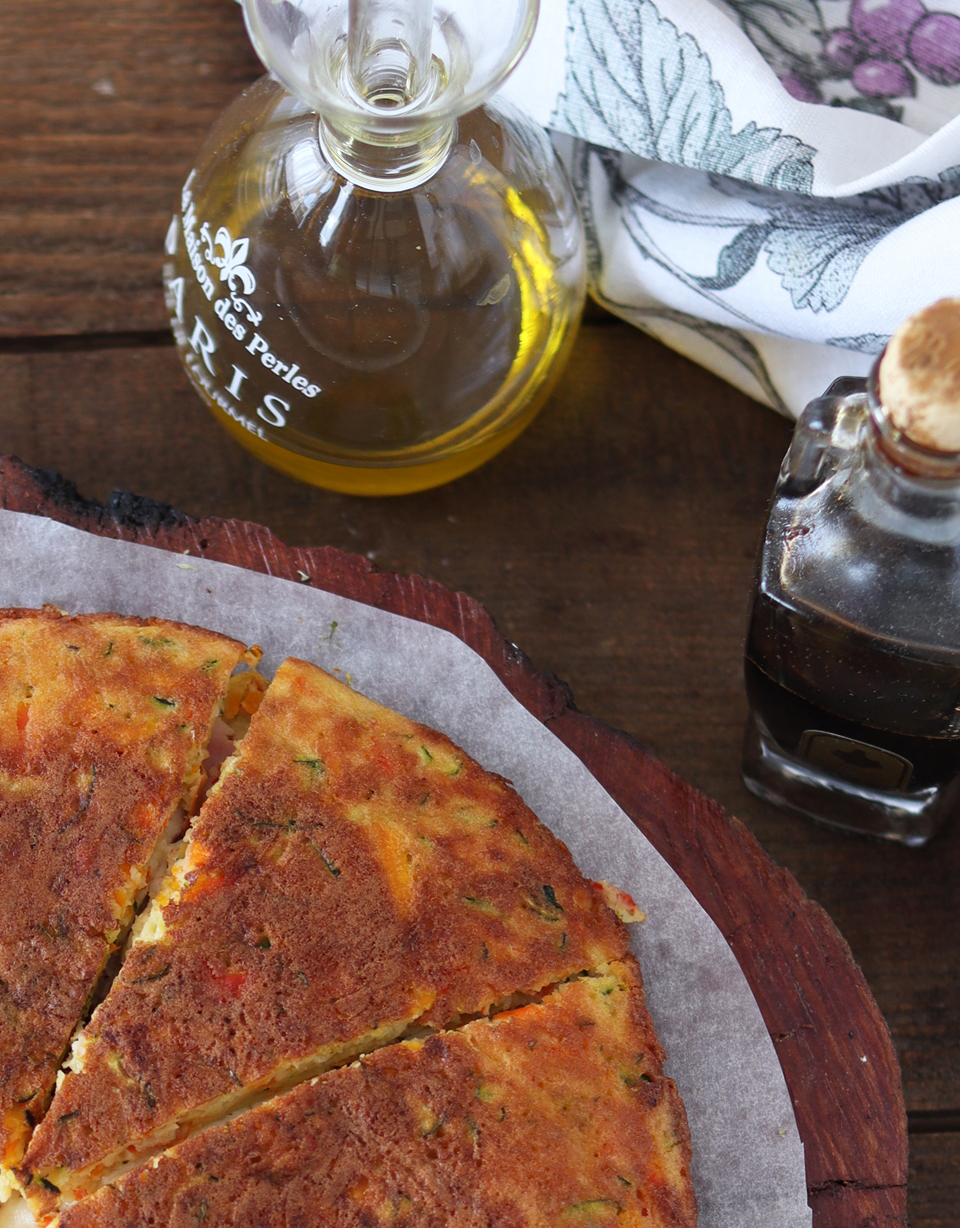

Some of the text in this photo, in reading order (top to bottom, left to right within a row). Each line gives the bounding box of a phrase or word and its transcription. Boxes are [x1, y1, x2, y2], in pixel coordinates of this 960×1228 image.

[164, 213, 290, 428] ARIS
[182, 202, 215, 301] Maison
[214, 298, 246, 341] des
[245, 332, 321, 399] Perles
